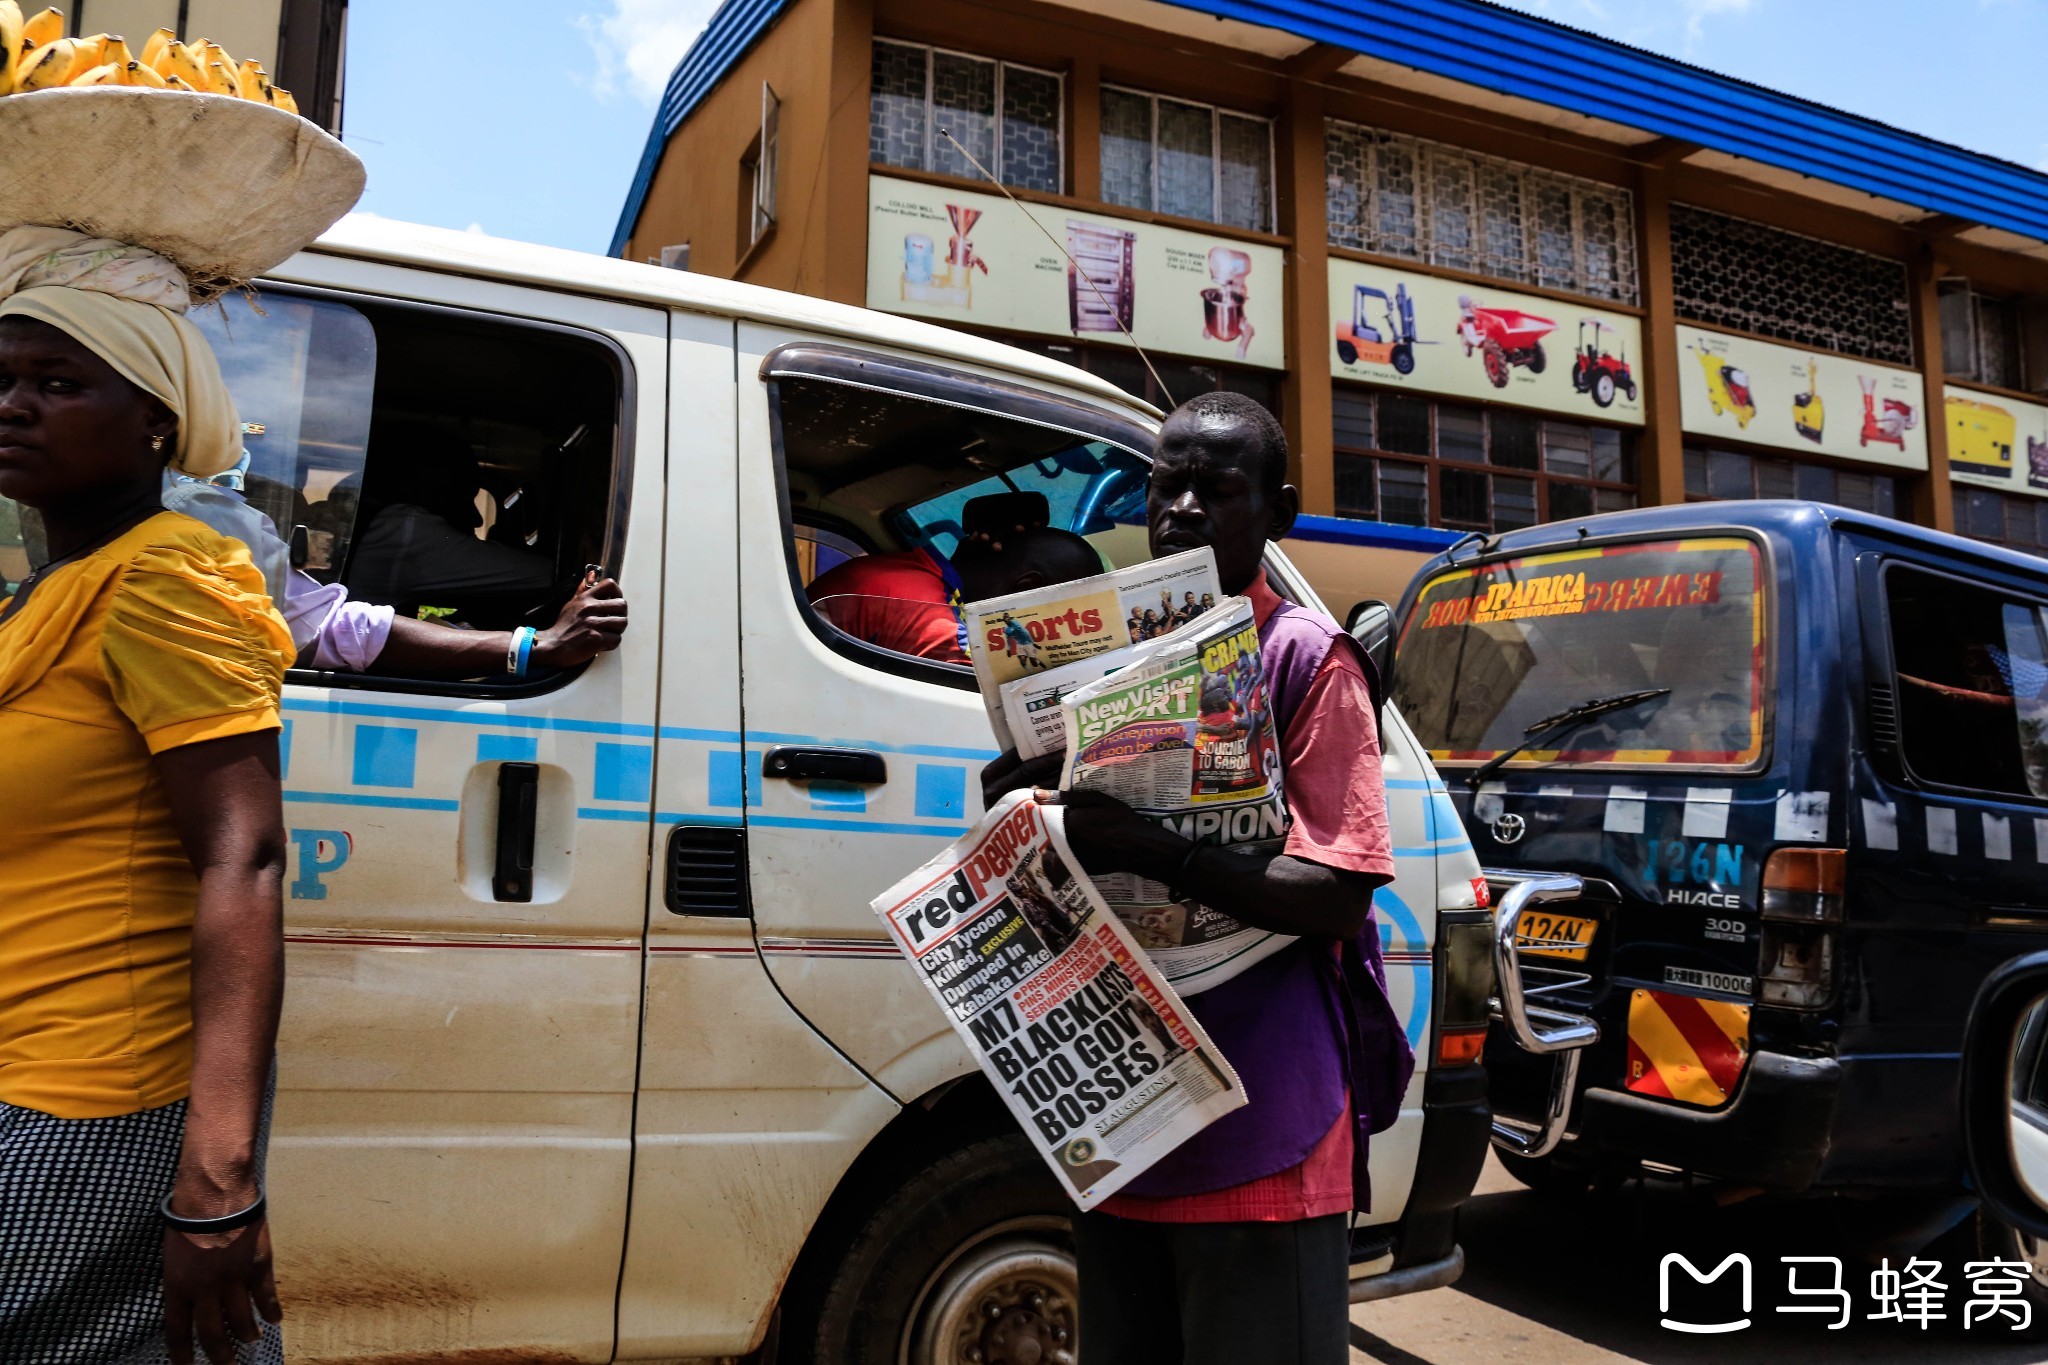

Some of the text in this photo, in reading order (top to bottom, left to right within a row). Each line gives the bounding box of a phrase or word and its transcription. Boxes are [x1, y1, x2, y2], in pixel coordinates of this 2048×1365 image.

[1082, 686, 1194, 745] SPORT
[1103, 725, 1186, 745] honeymoon
[1100, 745, 1133, 758] soon
[1136, 740, 1154, 753] be
[1156, 738, 1189, 750] over
[1199, 755, 1213, 769] TO
[1667, 889, 1741, 909] HIACE
[920, 907, 1006, 974] City Tycoon
[932, 916, 1025, 990] Killed, EXCLUSIVE
[943, 940, 1024, 1006] Dumped In
[953, 947, 1052, 1023] Kabaka Lake
[1018, 990, 1044, 1012] PINS
[967, 998, 1021, 1053] M7
[990, 961, 1135, 1085] BLACKLISTS
[1025, 981, 1078, 1023] SERVANTS
[1013, 1055, 1077, 1113] 100
[1032, 1040, 1160, 1147] BOSSES
[1107, 1074, 1172, 1125] AUGUSTINE
